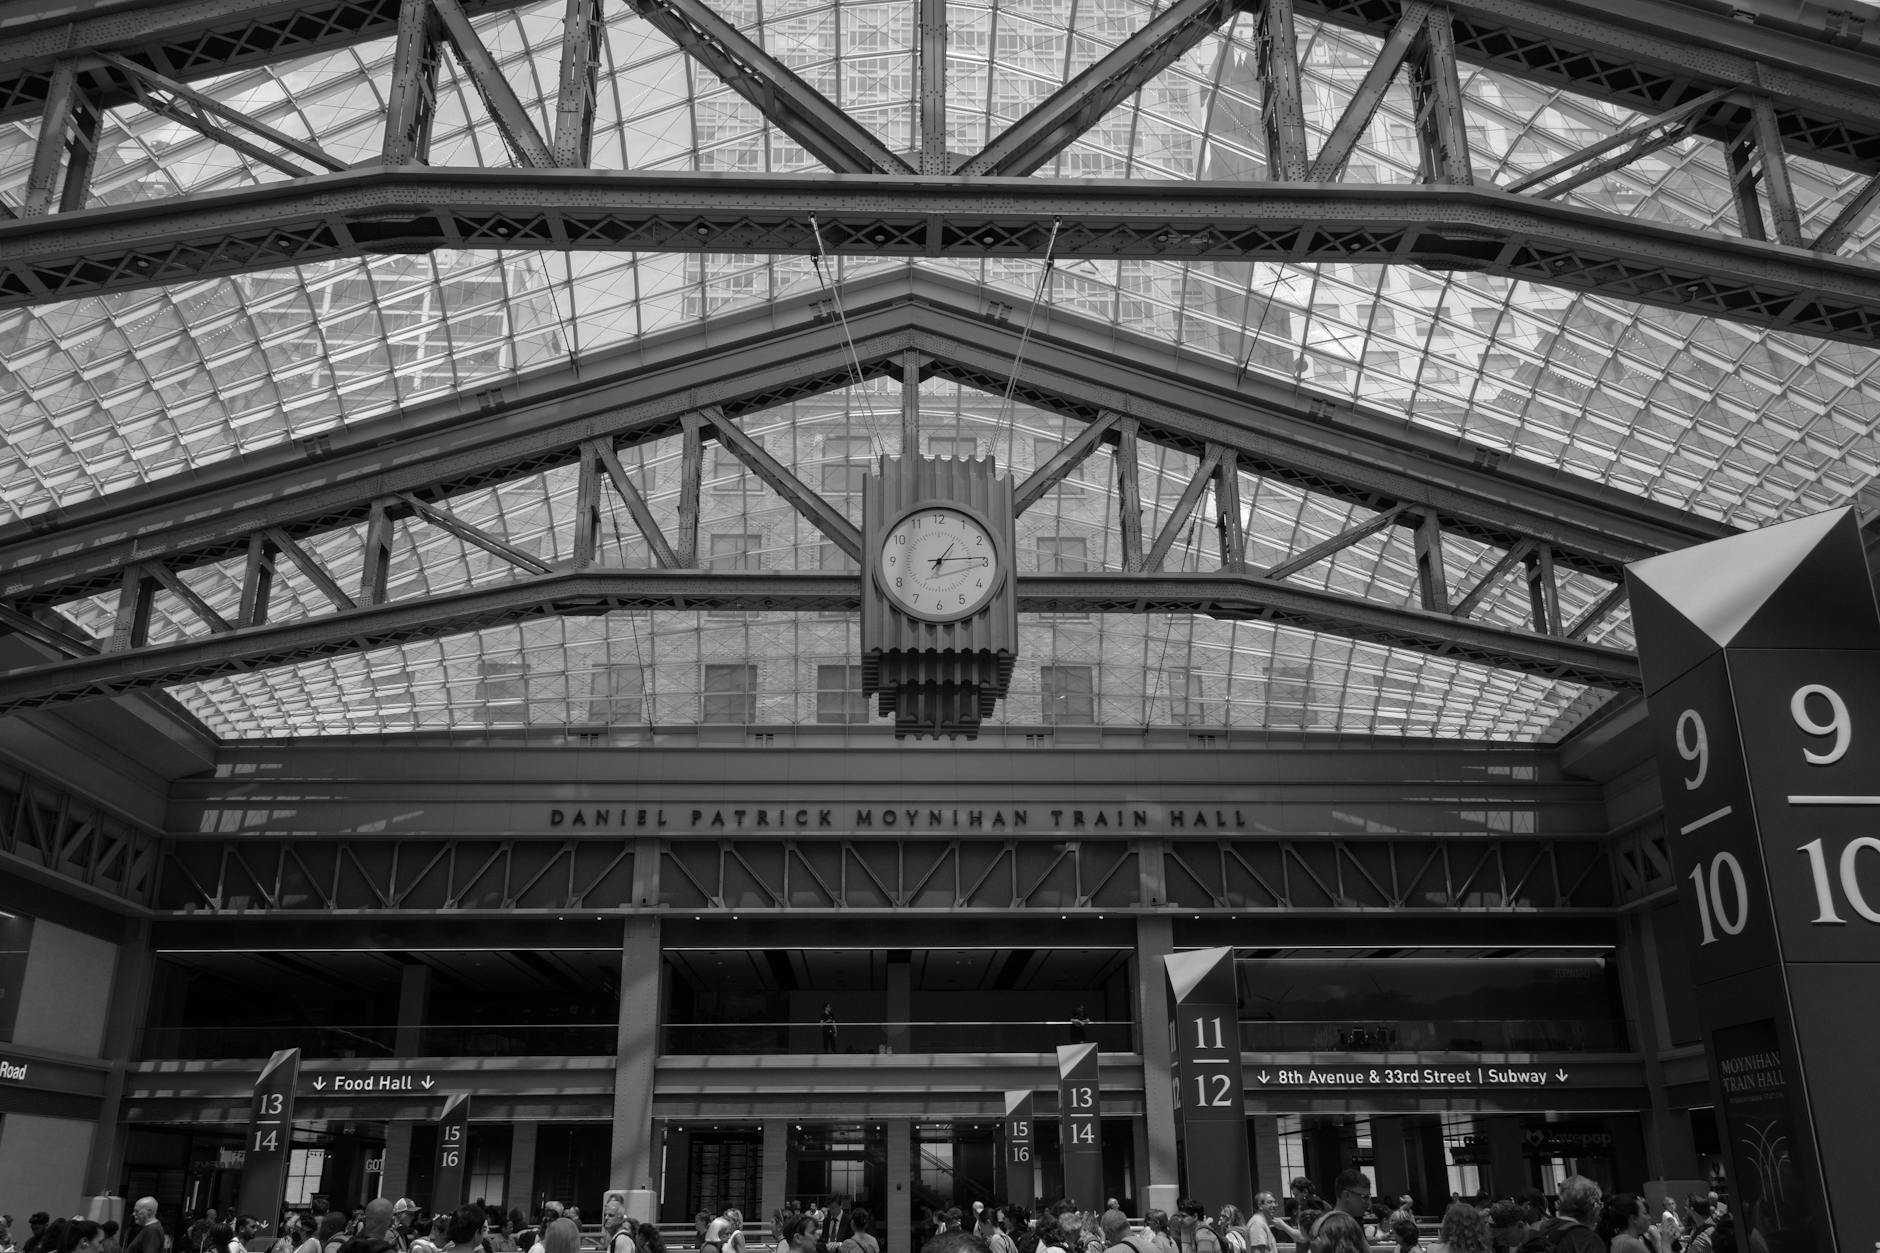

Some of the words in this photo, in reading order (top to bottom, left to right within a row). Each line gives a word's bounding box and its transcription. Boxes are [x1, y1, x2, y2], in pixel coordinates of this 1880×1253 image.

[911, 519, 922, 529] 11
[933, 514, 945, 525] 12
[961, 519, 966, 529] 1
[893, 534, 906, 545] 10
[976, 535, 983, 546] 2
[890, 556, 896, 567] 9
[982, 557, 989, 568] 3
[895, 577, 903, 588] 8
[975, 578, 983, 588] 4
[912, 594, 920, 604] 7
[936, 600, 943, 611] 6
[958, 594, 966, 605] 5
[1790, 684, 1852, 765] 9
[1676, 709, 1709, 791] 9
[551, 809, 667, 826] DANIEL
[691, 809, 832, 826] PATRICK
[856, 809, 1028, 826] MOYNIHAN
[1050, 810, 1147, 826] TRAIN
[1170, 810, 1246, 826] HALL
[1689, 851, 1749, 946] 10
[1192, 1016, 1226, 1049] 11
[1720, 1050, 1782, 1074] MOYNIHAN
[0, 1061, 27, 1080] Road
[1278, 1070, 1304, 1084] 8th
[1308, 1069, 1364, 1084] Avenue
[1368, 1069, 1381, 1084] &
[1384, 1069, 1419, 1084] 33rd
[1423, 1069, 1472, 1083] Street
[1488, 1069, 1547, 1085] Subway
[334, 1075, 374, 1090] Food
[379, 1075, 413, 1090] Hall
[1721, 1073, 1756, 1092] TRAIN
[1756, 1069, 1786, 1088] HALL
[1070, 1087, 1093, 1108] 13
[1193, 1074, 1233, 1107] 12
[259, 1093, 284, 1115] 13
[443, 1125, 461, 1141] 15
[1012, 1121, 1029, 1137] 15
[1070, 1122, 1096, 1144] 14
[252, 1130, 279, 1152] 14
[441, 1151, 459, 1167] 16
[1013, 1146, 1030, 1162] 16
